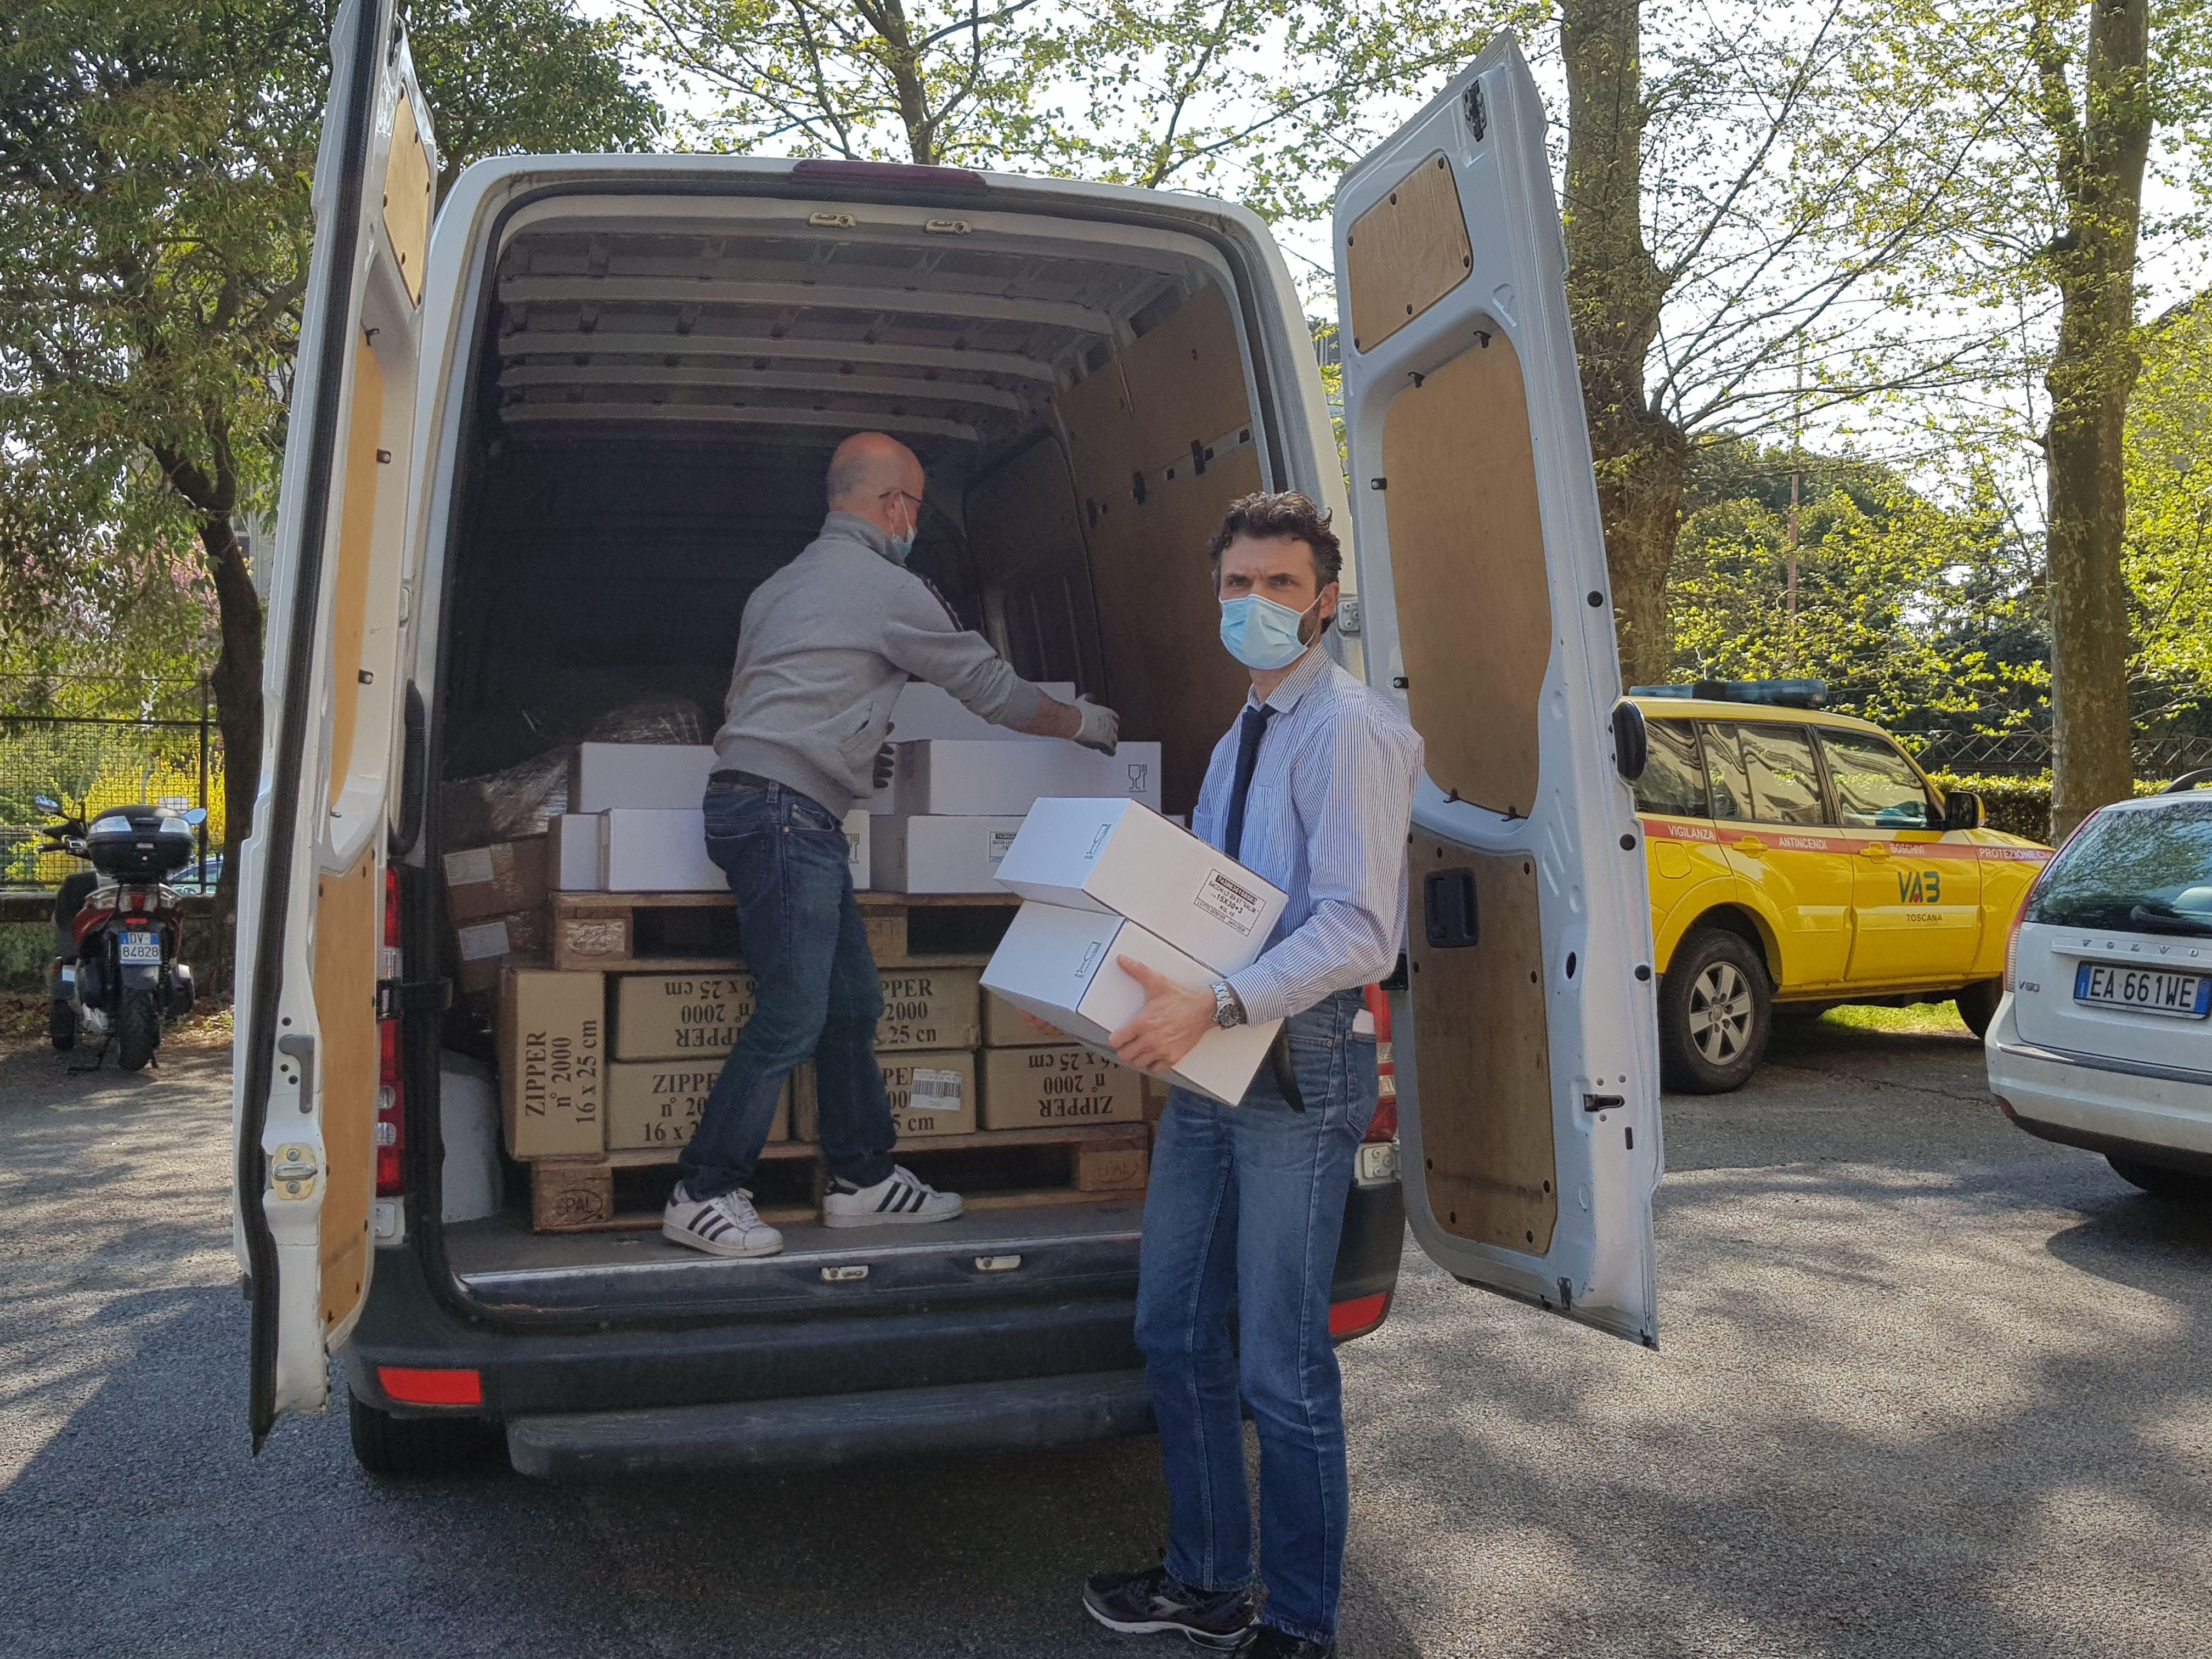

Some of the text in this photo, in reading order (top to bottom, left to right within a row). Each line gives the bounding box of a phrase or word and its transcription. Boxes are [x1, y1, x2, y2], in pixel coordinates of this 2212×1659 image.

[1668, 825, 1715, 840] VIGILANZA
[1779, 837, 1827, 849] ANTINCENDI
[1980, 849, 2037, 859] PROTEZIONE
[130, 934, 143, 943] DV
[123, 946, 158, 957] 84828
[2083, 939, 2199, 958] VOLVO
[664, 981, 693, 995] cm
[700, 980, 722, 999] 25
[729, 980, 738, 994] x
[879, 979, 933, 997] PPER
[2091, 969, 2114, 998] EA
[2124, 973, 2196, 1008] 661WE
[681, 1004, 725, 1024] 2000
[885, 1001, 927, 1021] 2000
[675, 1027, 742, 1047] IPPER
[889, 1025, 910, 1043] 25
[551, 1037, 572, 1083] 2000
[1029, 1053, 1054, 1068] cm
[1060, 1053, 1080, 1071] 25
[1085, 1052, 1095, 1065] x
[525, 1031, 546, 1116] ZIPPER
[576, 1019, 597, 1124] 16 x 25 cm
[652, 1073, 718, 1093] ZIPPE
[1043, 1075, 1084, 1094] 2000
[686, 1097, 706, 1116] 20
[1038, 1096, 1113, 1117] ZIPPER
[644, 1122, 667, 1141] 16
[673, 1126, 683, 1140] x
[908, 1117, 934, 1131] cm
